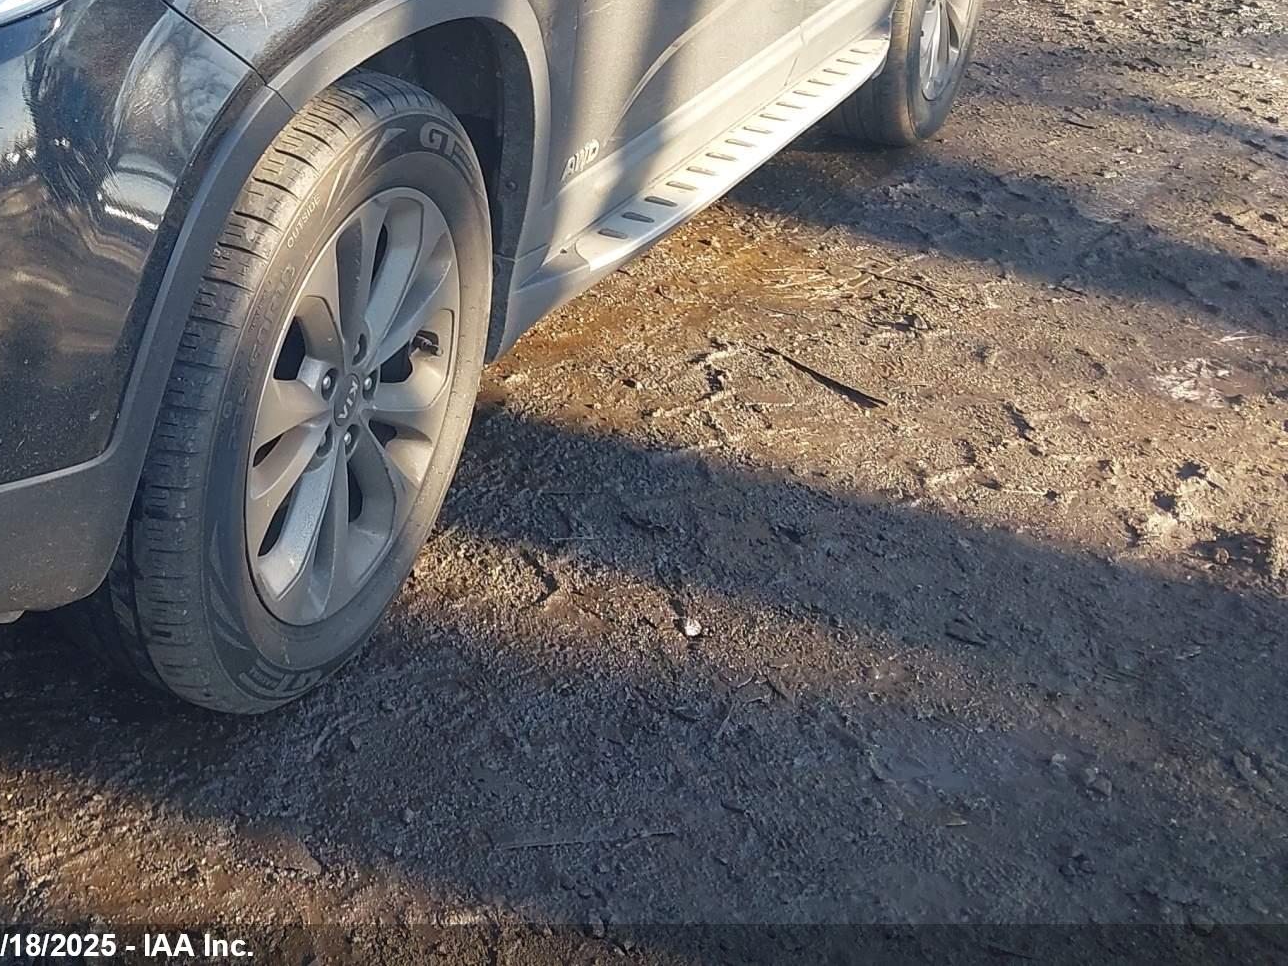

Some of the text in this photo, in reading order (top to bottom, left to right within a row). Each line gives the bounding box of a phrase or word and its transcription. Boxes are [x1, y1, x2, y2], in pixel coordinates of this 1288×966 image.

[560, 139, 600, 185] AWD
[287, 193, 321, 248] OUTSIDE
[337, 379, 358, 419] KIA
